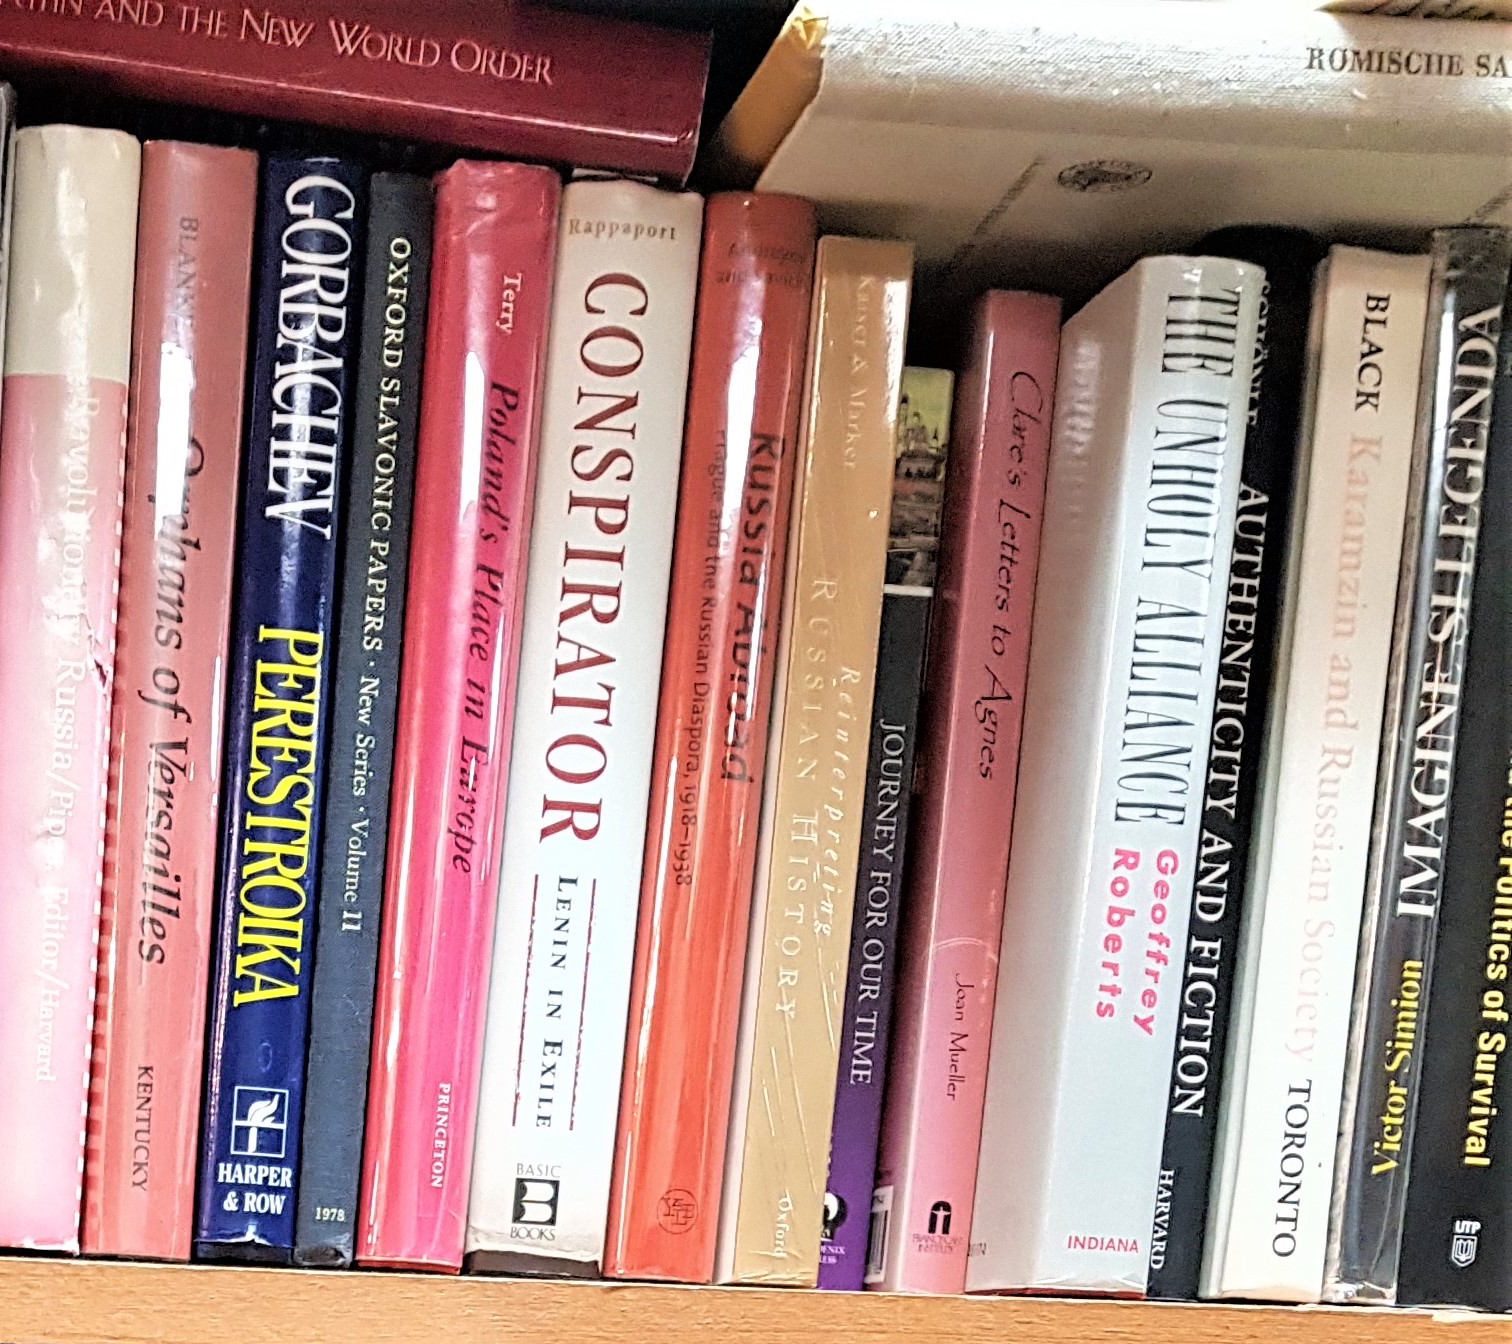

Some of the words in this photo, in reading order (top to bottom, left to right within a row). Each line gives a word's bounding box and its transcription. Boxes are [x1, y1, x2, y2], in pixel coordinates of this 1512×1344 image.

[264, 174, 356, 540] GORBACHEV
[1162, 291, 1242, 378] THE
[1354, 292, 1390, 414] BLACK
[539, 273, 649, 843] CONSPIRATOR
[1142, 400, 1230, 586] UNHOLY
[1115, 597, 1207, 828] ALLIANCE
[234, 626, 324, 1008] PERESTROIKA
[1094, 848, 1141, 1021] Roberts
[1132, 849, 1180, 1038] Geoffrey
[129, 1064, 154, 1192] KENTUCKY
[217, 1162, 292, 1188] HARPER
[1273, 1078, 1312, 1258] TORONTO
[1463, 1033, 1506, 1169] Survival
[223, 1193, 237, 1212] &
[243, 1192, 286, 1214] ROW
[315, 1206, 346, 1221] 1978
[1067, 1235, 1140, 1254] INDIANA
